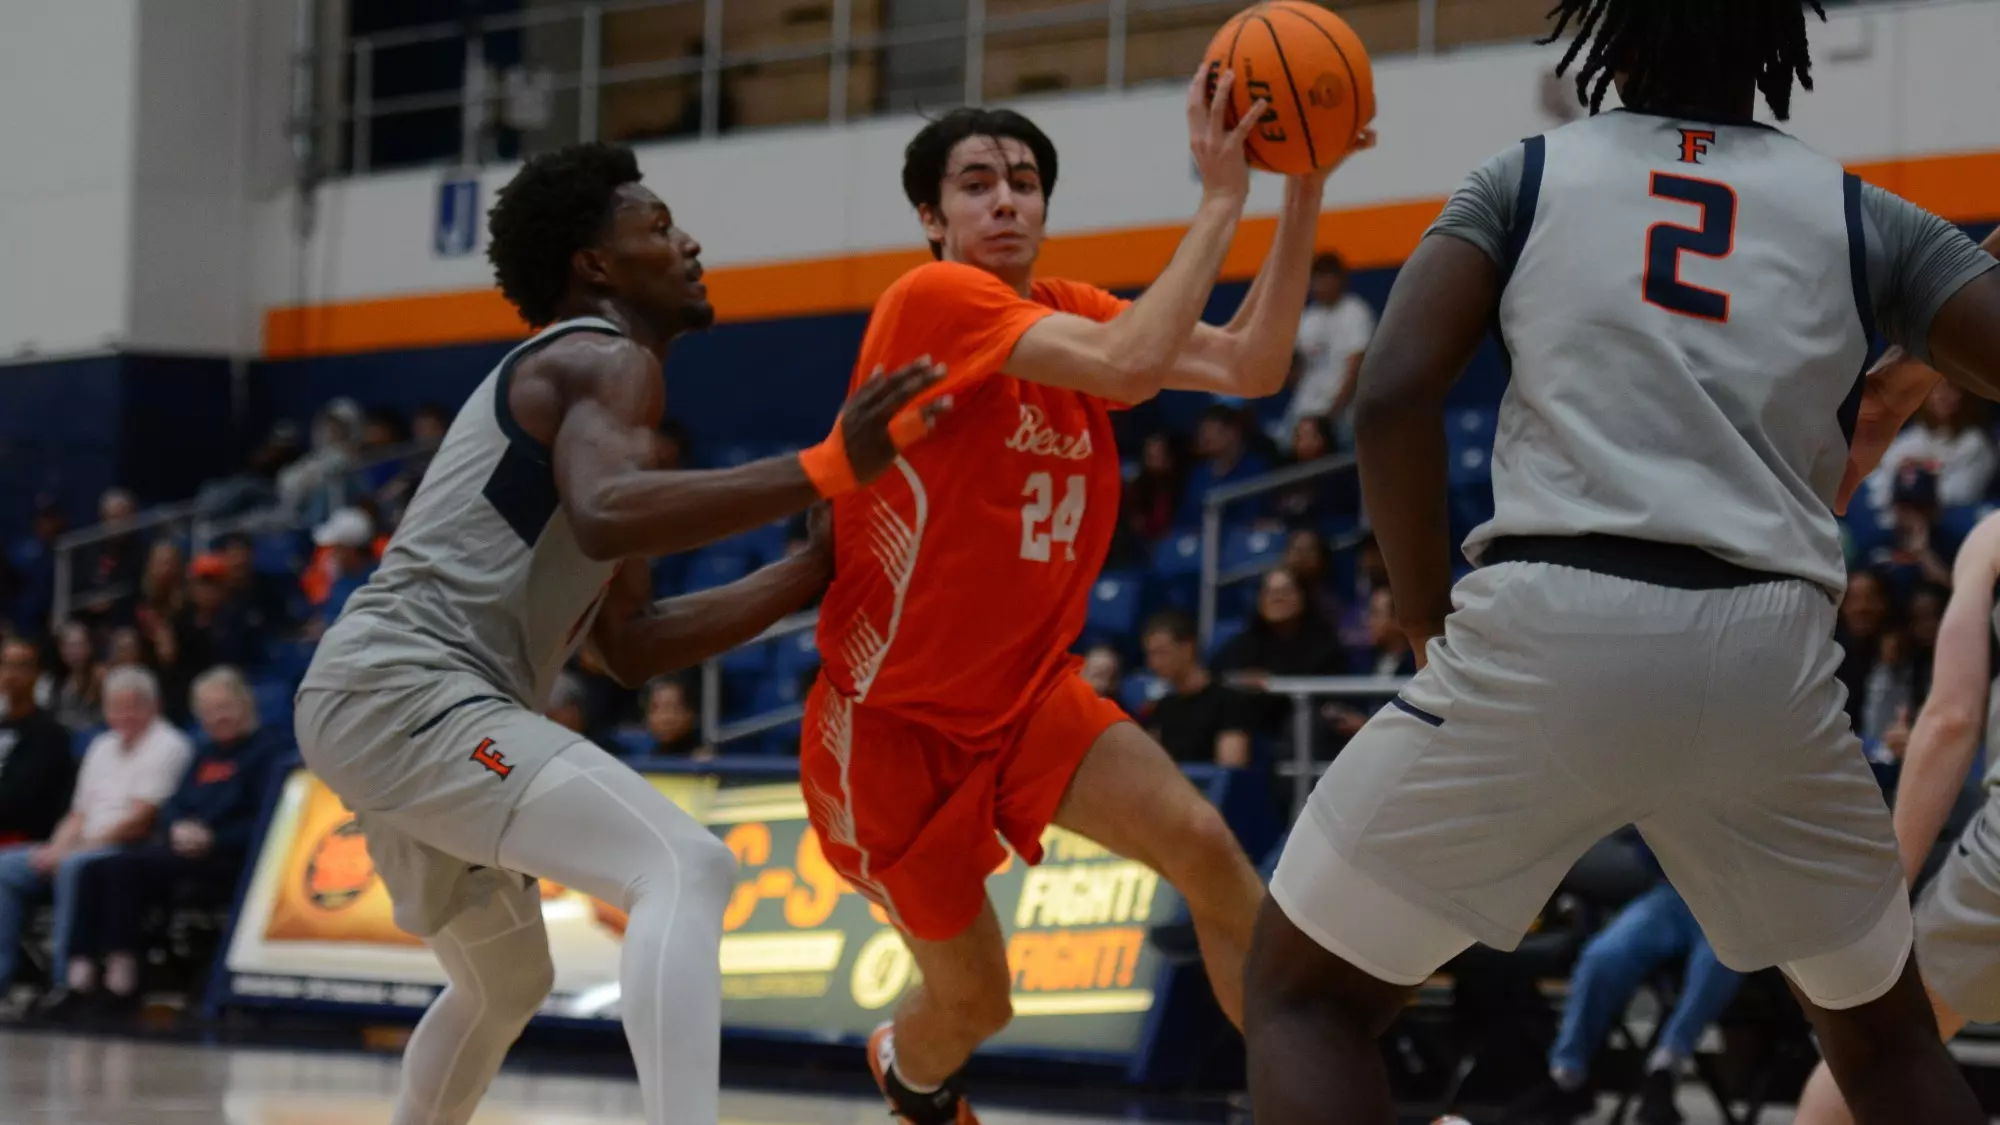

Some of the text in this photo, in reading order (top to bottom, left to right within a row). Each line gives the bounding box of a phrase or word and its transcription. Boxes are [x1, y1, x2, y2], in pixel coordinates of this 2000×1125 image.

[1677, 128, 1716, 164] F
[1641, 170, 1738, 324] 2
[1020, 471, 1086, 562] 24
[469, 737, 515, 781] F
[1014, 859, 1160, 929] FIGHT!
[1006, 926, 1145, 992] FIGHT!
